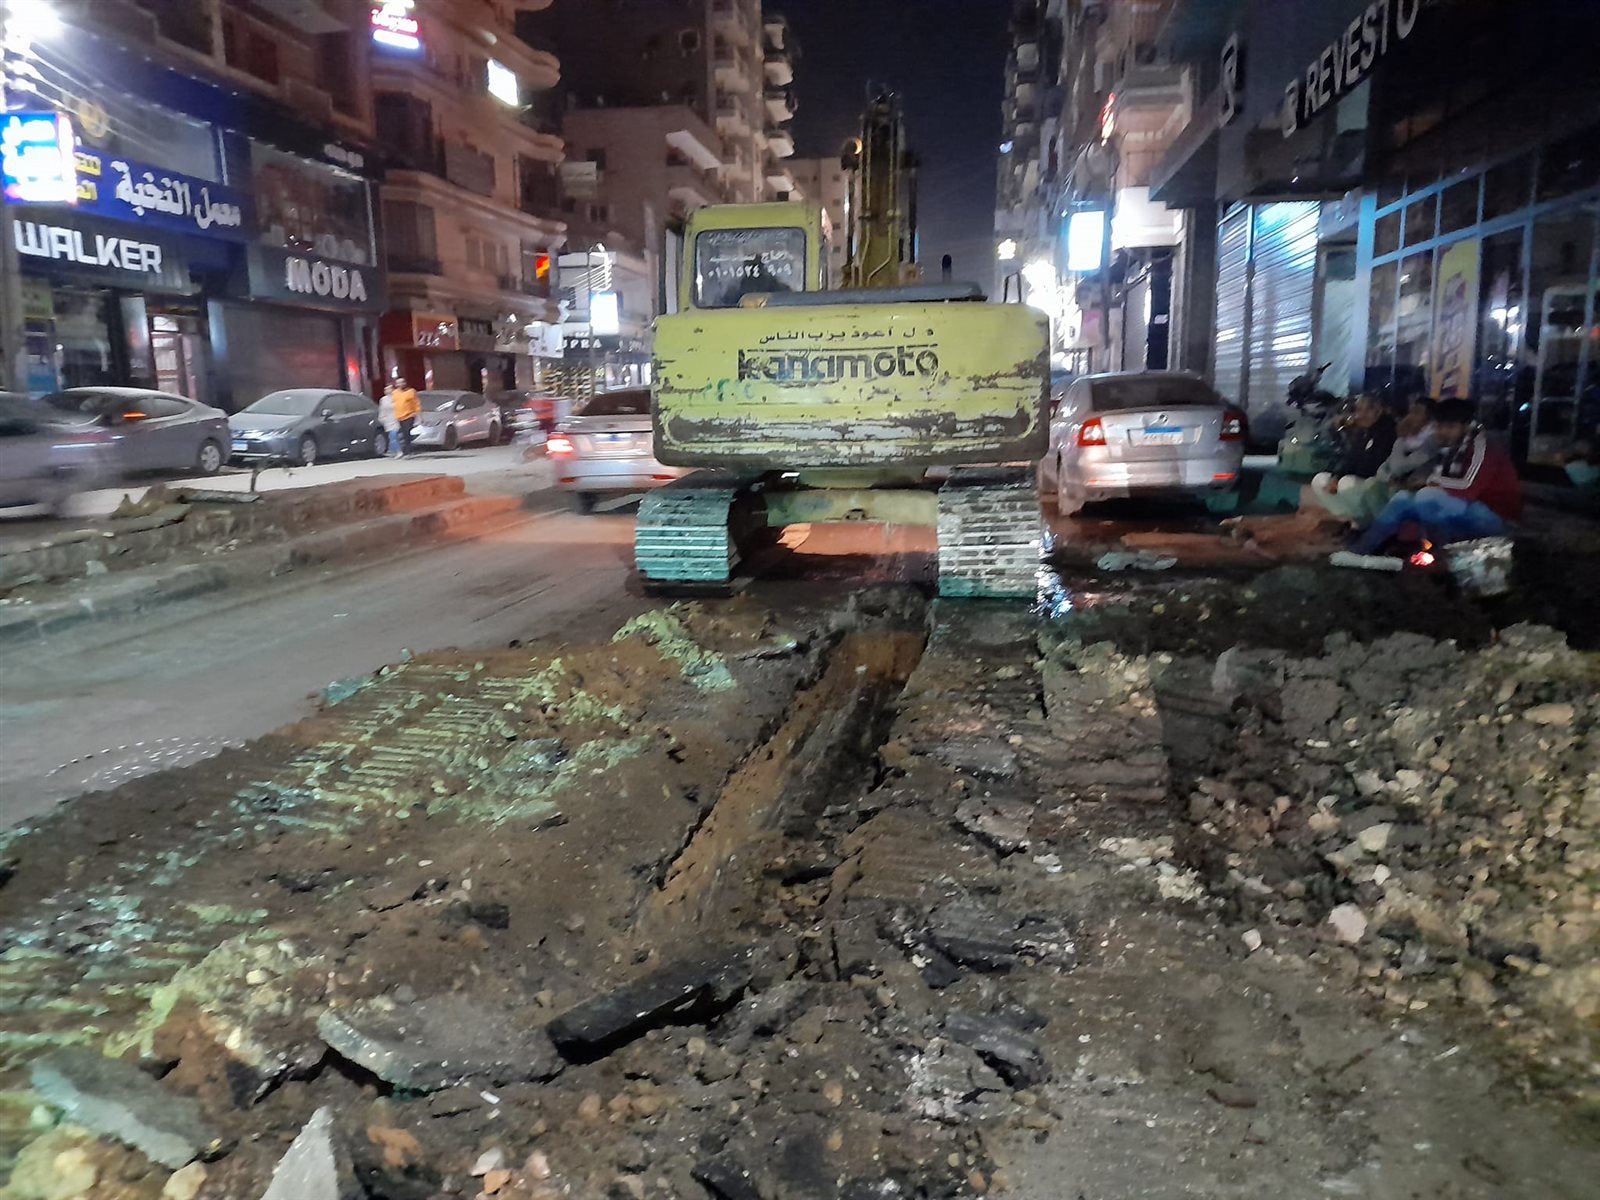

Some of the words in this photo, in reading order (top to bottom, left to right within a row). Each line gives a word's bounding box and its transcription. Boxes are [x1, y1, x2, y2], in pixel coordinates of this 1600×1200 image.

[13, 219, 162, 274] WALKER
[286, 256, 367, 301] MODA
[759, 331, 804, 344] الناس
[738, 346, 939, 382] kanamoto
